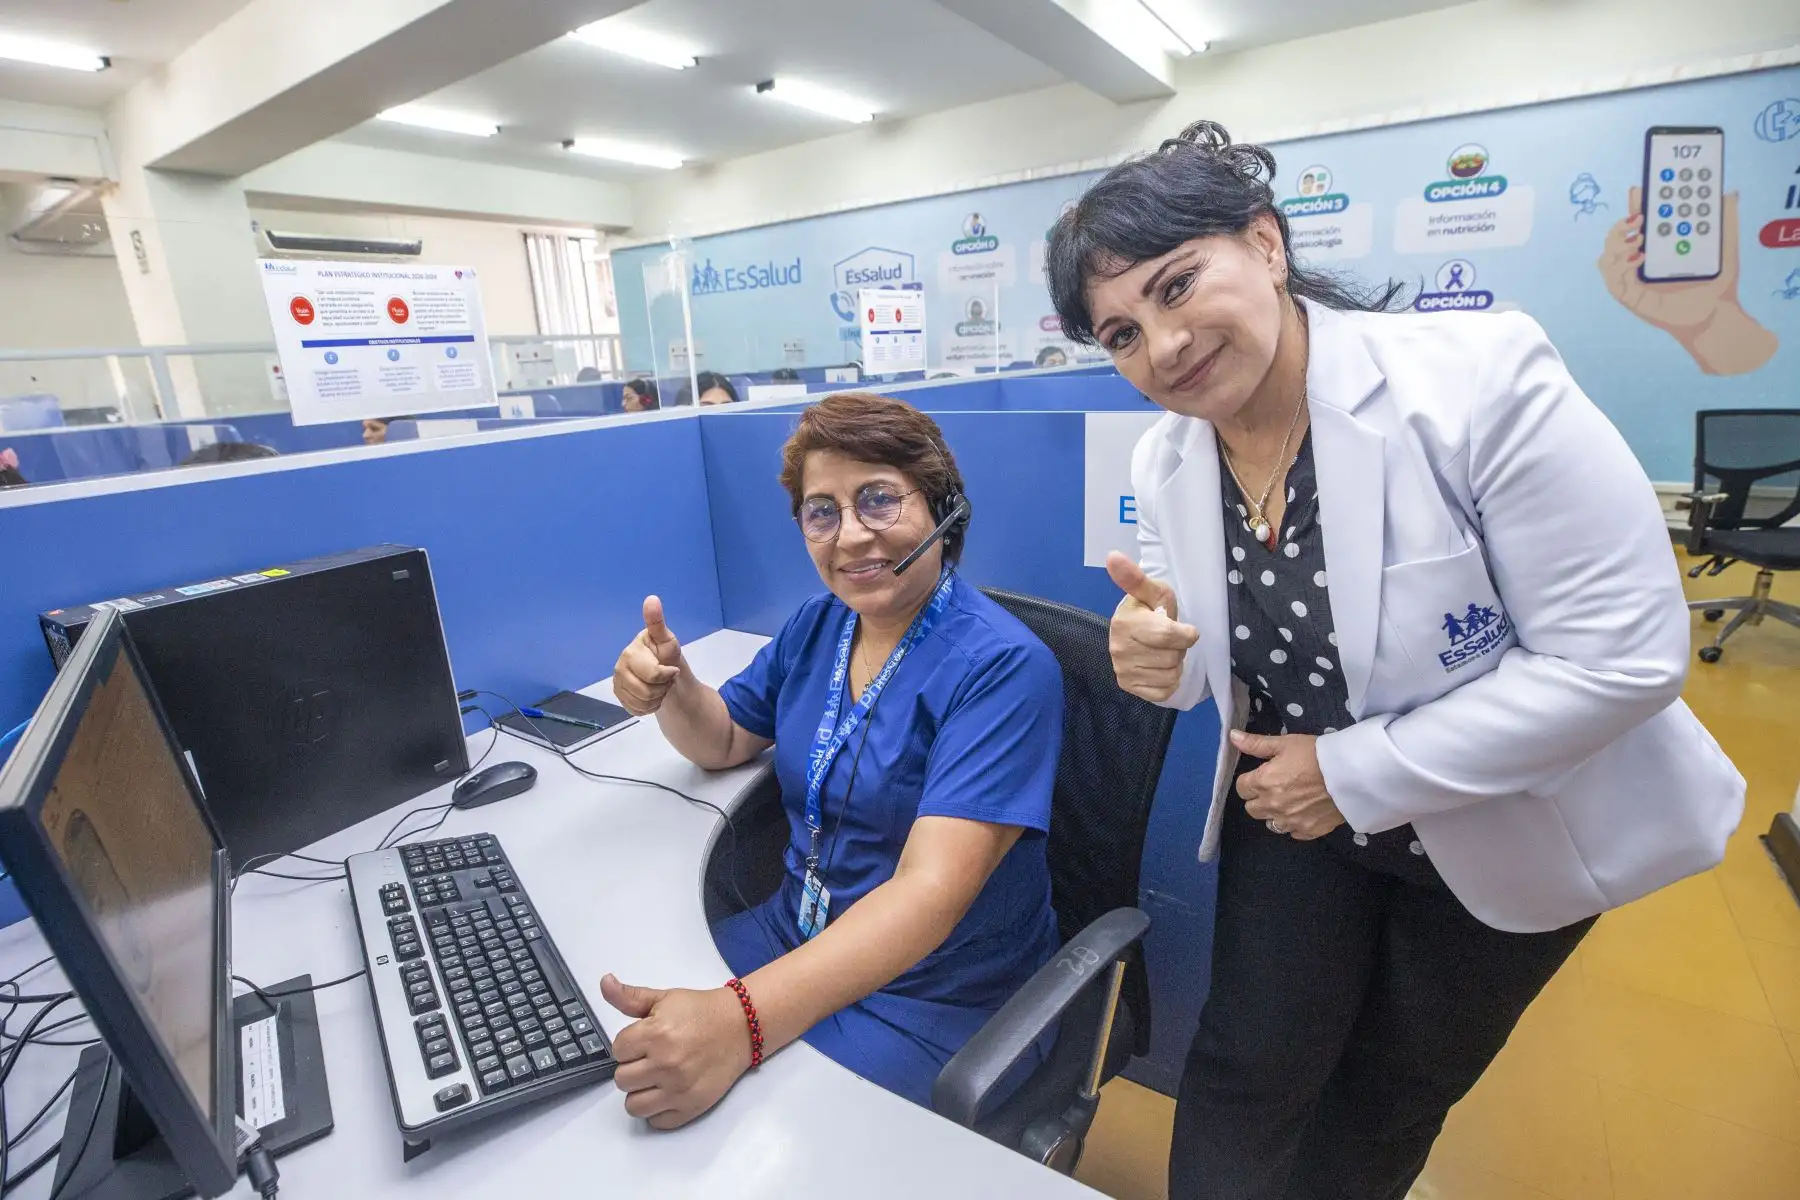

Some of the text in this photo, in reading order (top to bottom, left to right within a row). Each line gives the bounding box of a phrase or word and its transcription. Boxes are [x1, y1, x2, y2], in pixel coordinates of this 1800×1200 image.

[1673, 145, 1702, 159] 107
[1430, 180, 1501, 199] OPCIÓN 4
[1284, 198, 1344, 215] OPCIÓN 3
[1428, 209, 1496, 225] Información
[1427, 223, 1495, 237] en nutrición
[725, 257, 802, 292] EsSalud
[846, 263, 902, 285] EsSalud
[1420, 292, 1475, 309] OPCIÓN
[1439, 612, 1508, 667] EsSalud
